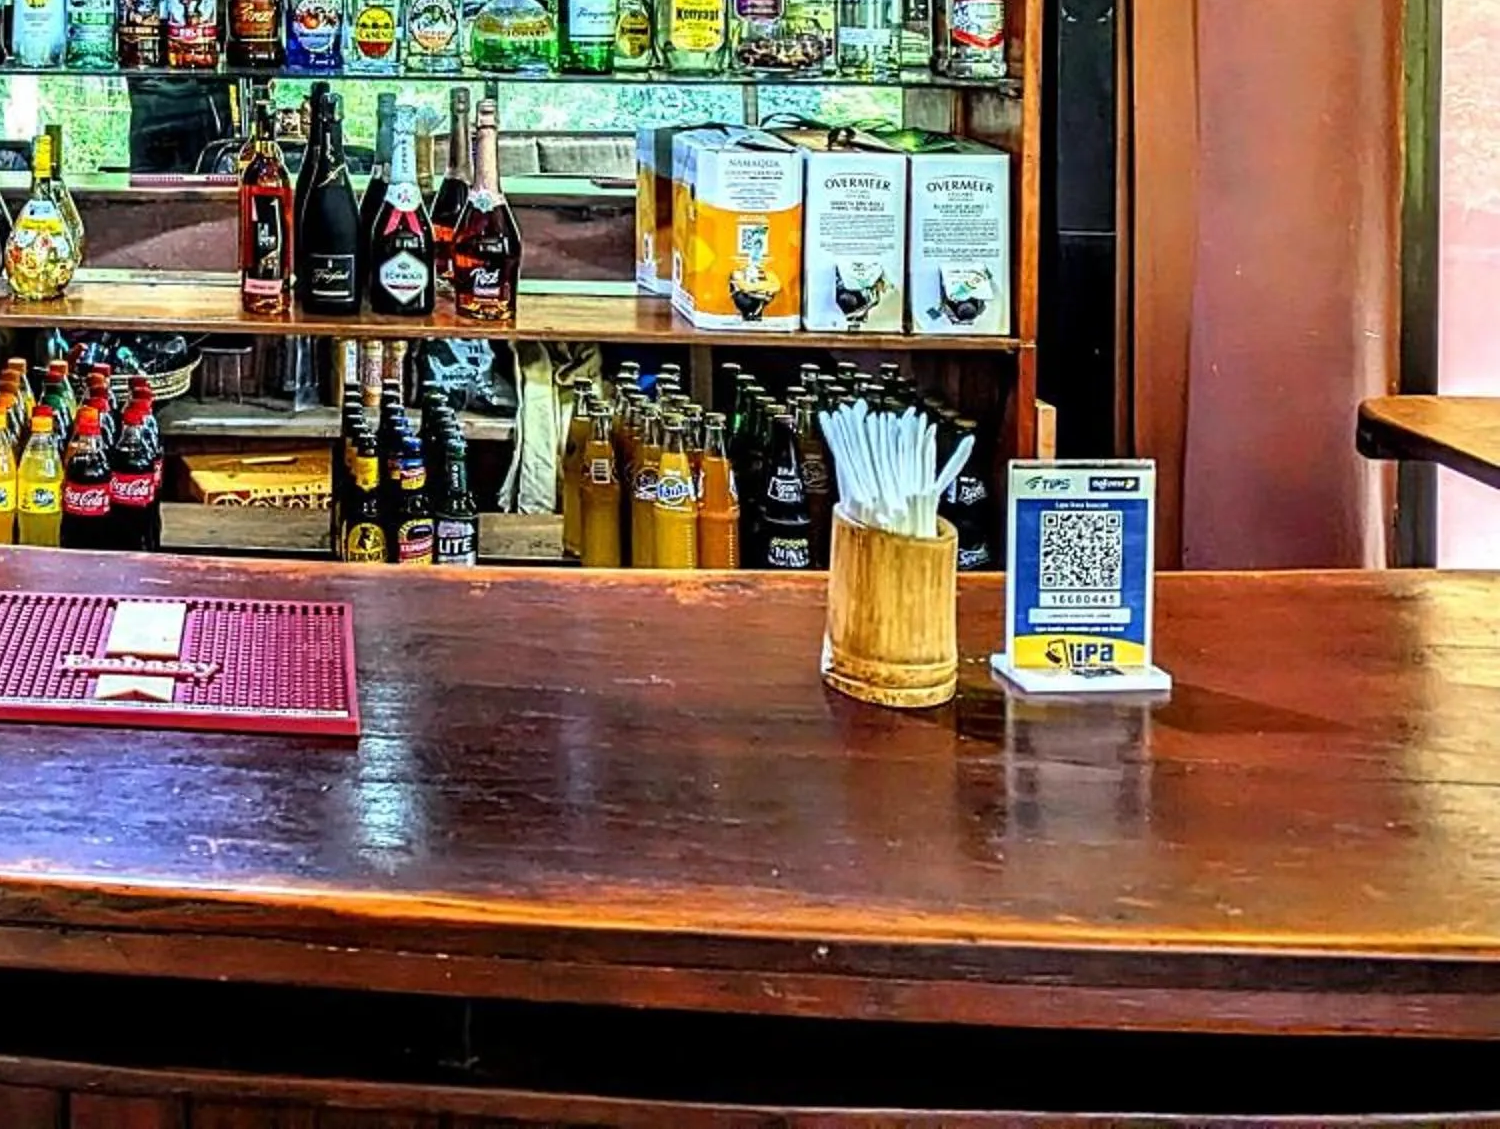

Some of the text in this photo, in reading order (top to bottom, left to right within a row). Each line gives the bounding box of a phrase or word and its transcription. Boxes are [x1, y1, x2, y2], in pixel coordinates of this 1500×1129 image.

[824, 177, 891, 191] OVERMEER
[926, 179, 994, 194] OVERMEER
[658, 484, 690, 498] Fanta
[439, 536, 473, 555] LITE
[63, 653, 220, 679] Embassy
